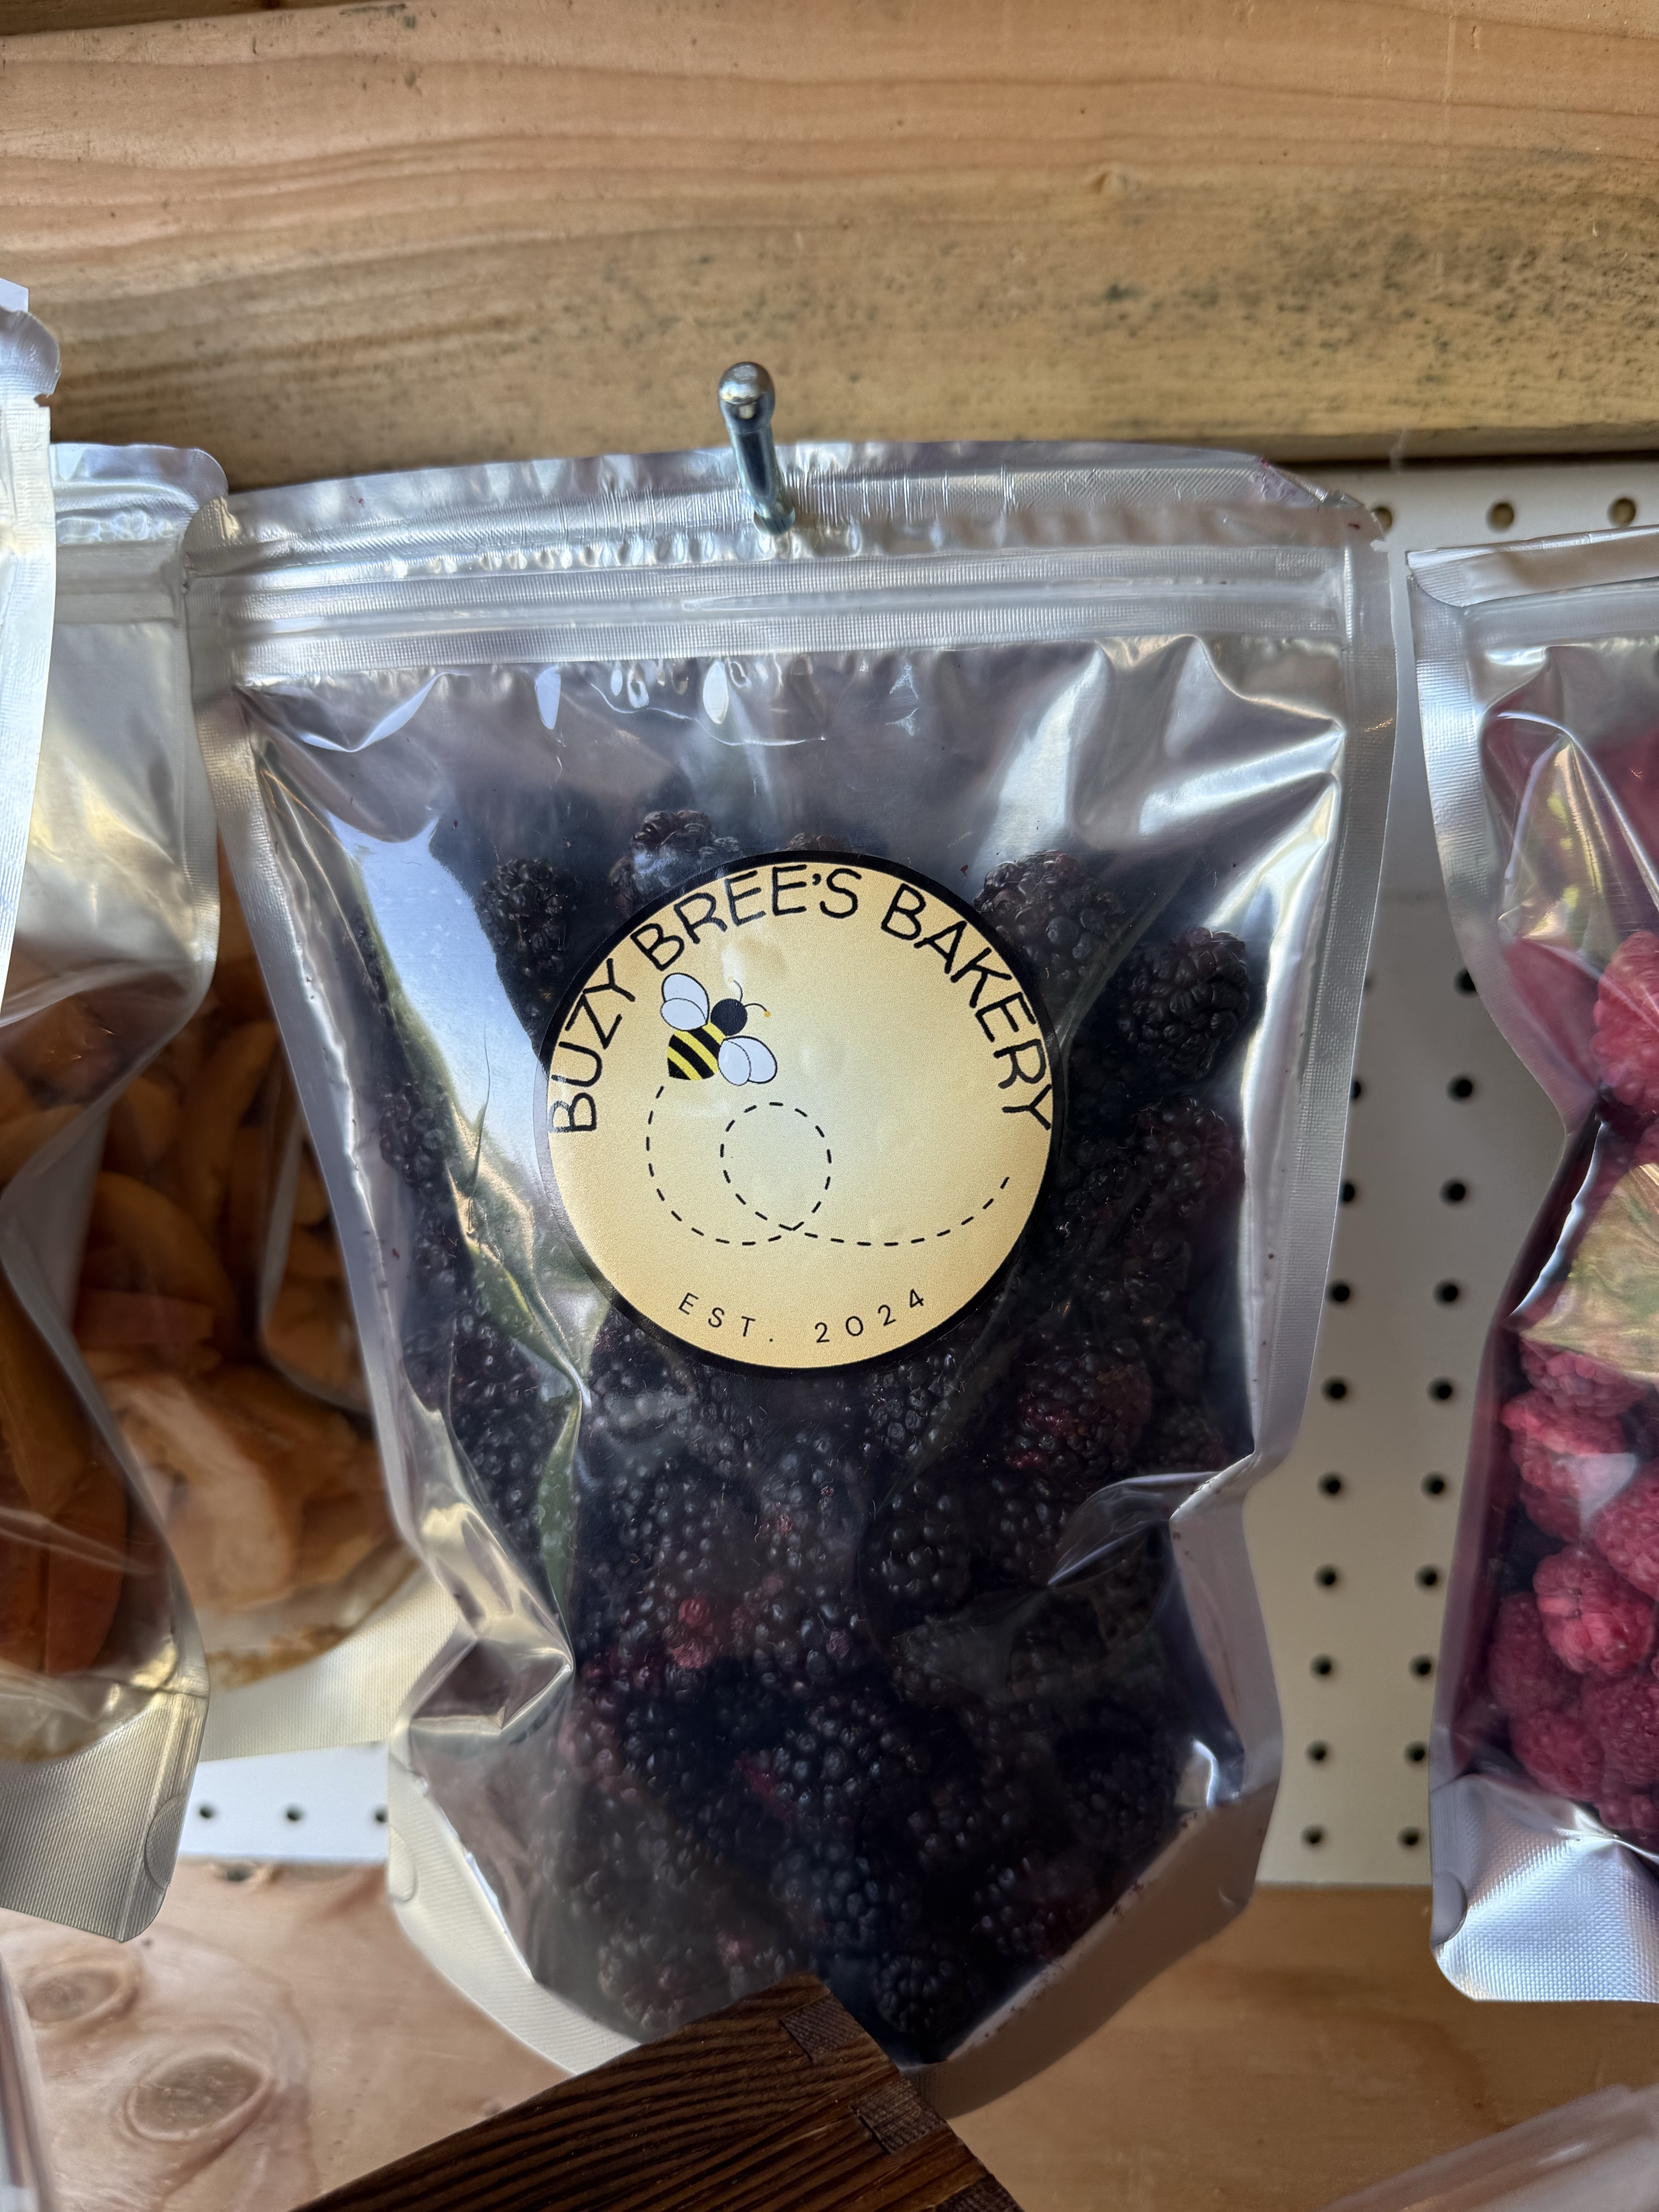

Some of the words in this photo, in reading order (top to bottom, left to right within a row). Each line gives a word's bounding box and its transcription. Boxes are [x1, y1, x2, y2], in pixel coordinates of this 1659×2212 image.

[548, 958, 635, 1133] BUZY
[630, 864, 862, 971] BREE'S
[880, 883, 1051, 1130] BAKERY
[678, 1292, 774, 1343] EST.
[815, 1288, 925, 1343] 2024
